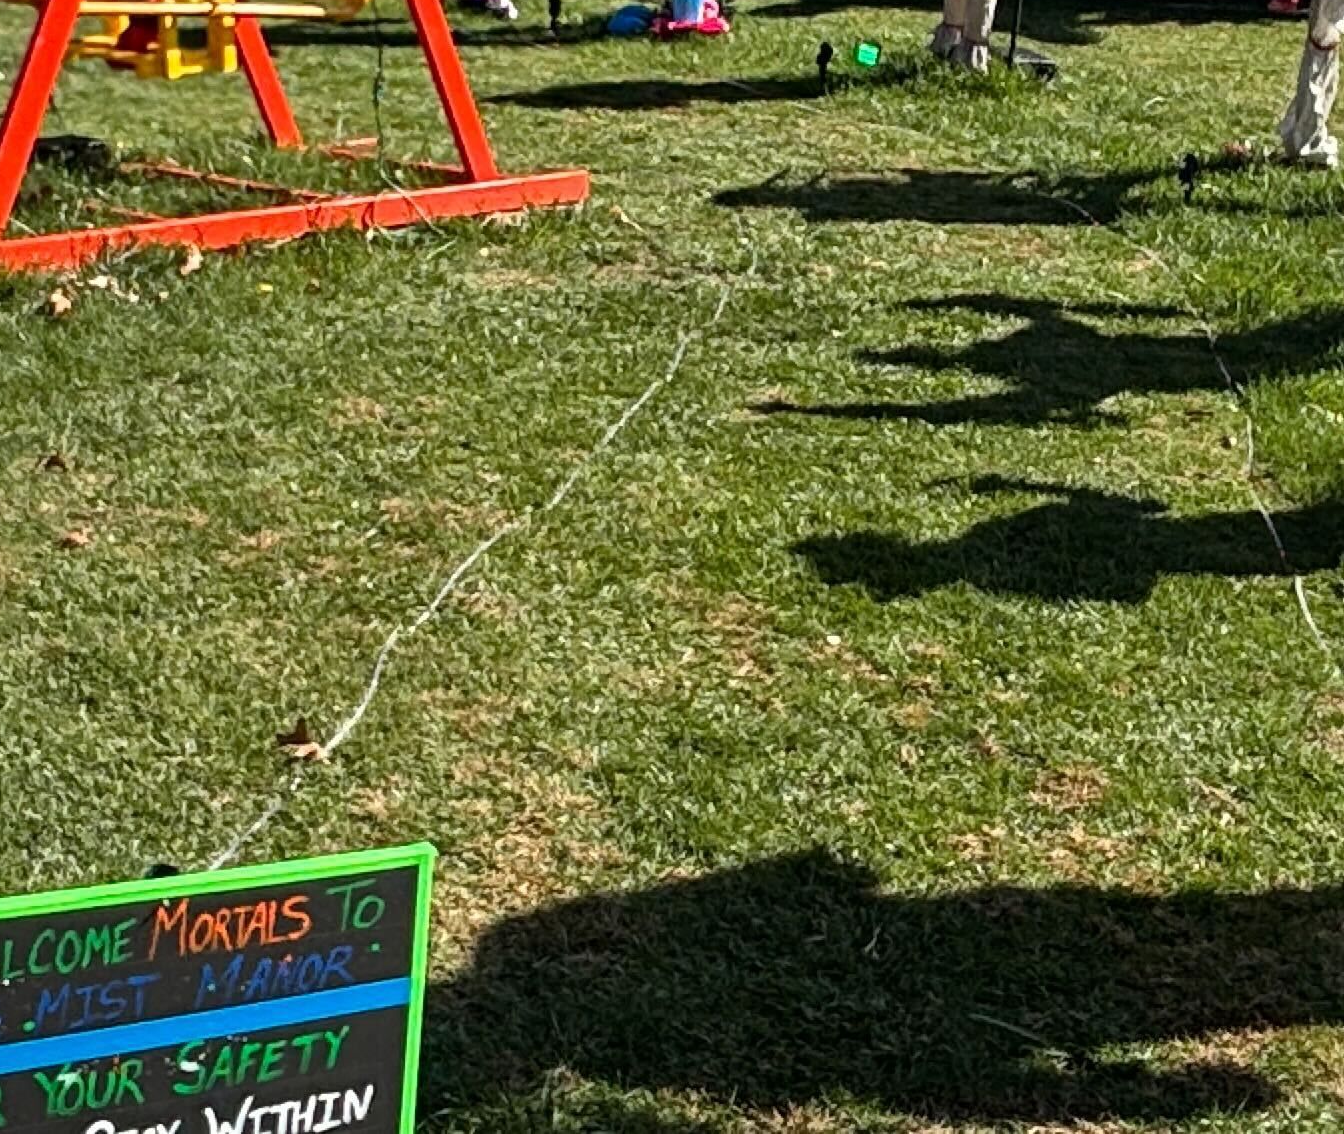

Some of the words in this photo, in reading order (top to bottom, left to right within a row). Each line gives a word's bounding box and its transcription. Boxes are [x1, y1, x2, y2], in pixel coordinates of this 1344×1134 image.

[148, 895, 312, 961] MORTALS
[35, 972, 161, 1034] MIST
[193, 945, 355, 1008] MANOR
[32, 1059, 145, 1115] YOUR
[173, 1026, 350, 1094] SAFETY
[203, 1084, 374, 1134] WITHIN
